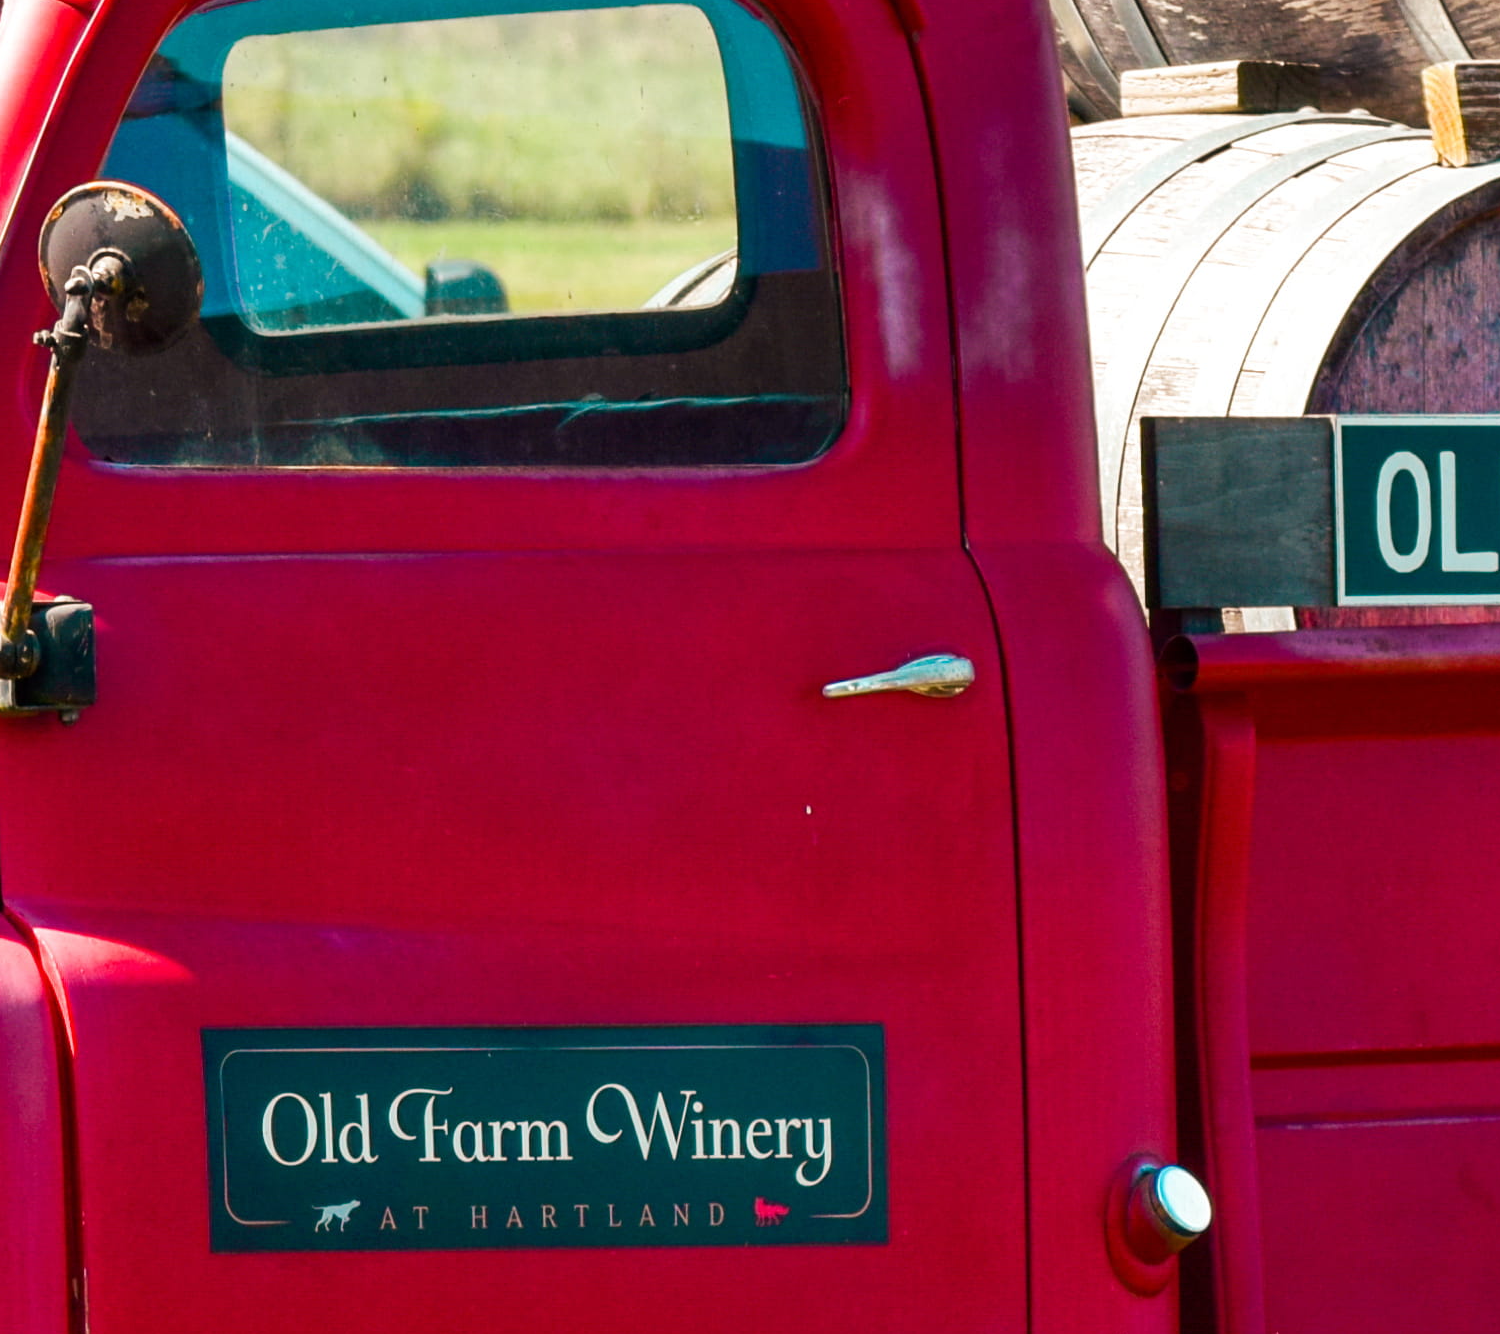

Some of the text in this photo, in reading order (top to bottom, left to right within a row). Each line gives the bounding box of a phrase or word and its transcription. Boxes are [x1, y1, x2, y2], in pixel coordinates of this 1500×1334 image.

[261, 1083, 833, 1187] Old Farm Winery
[379, 1202, 726, 1231] AT HARTLAND
